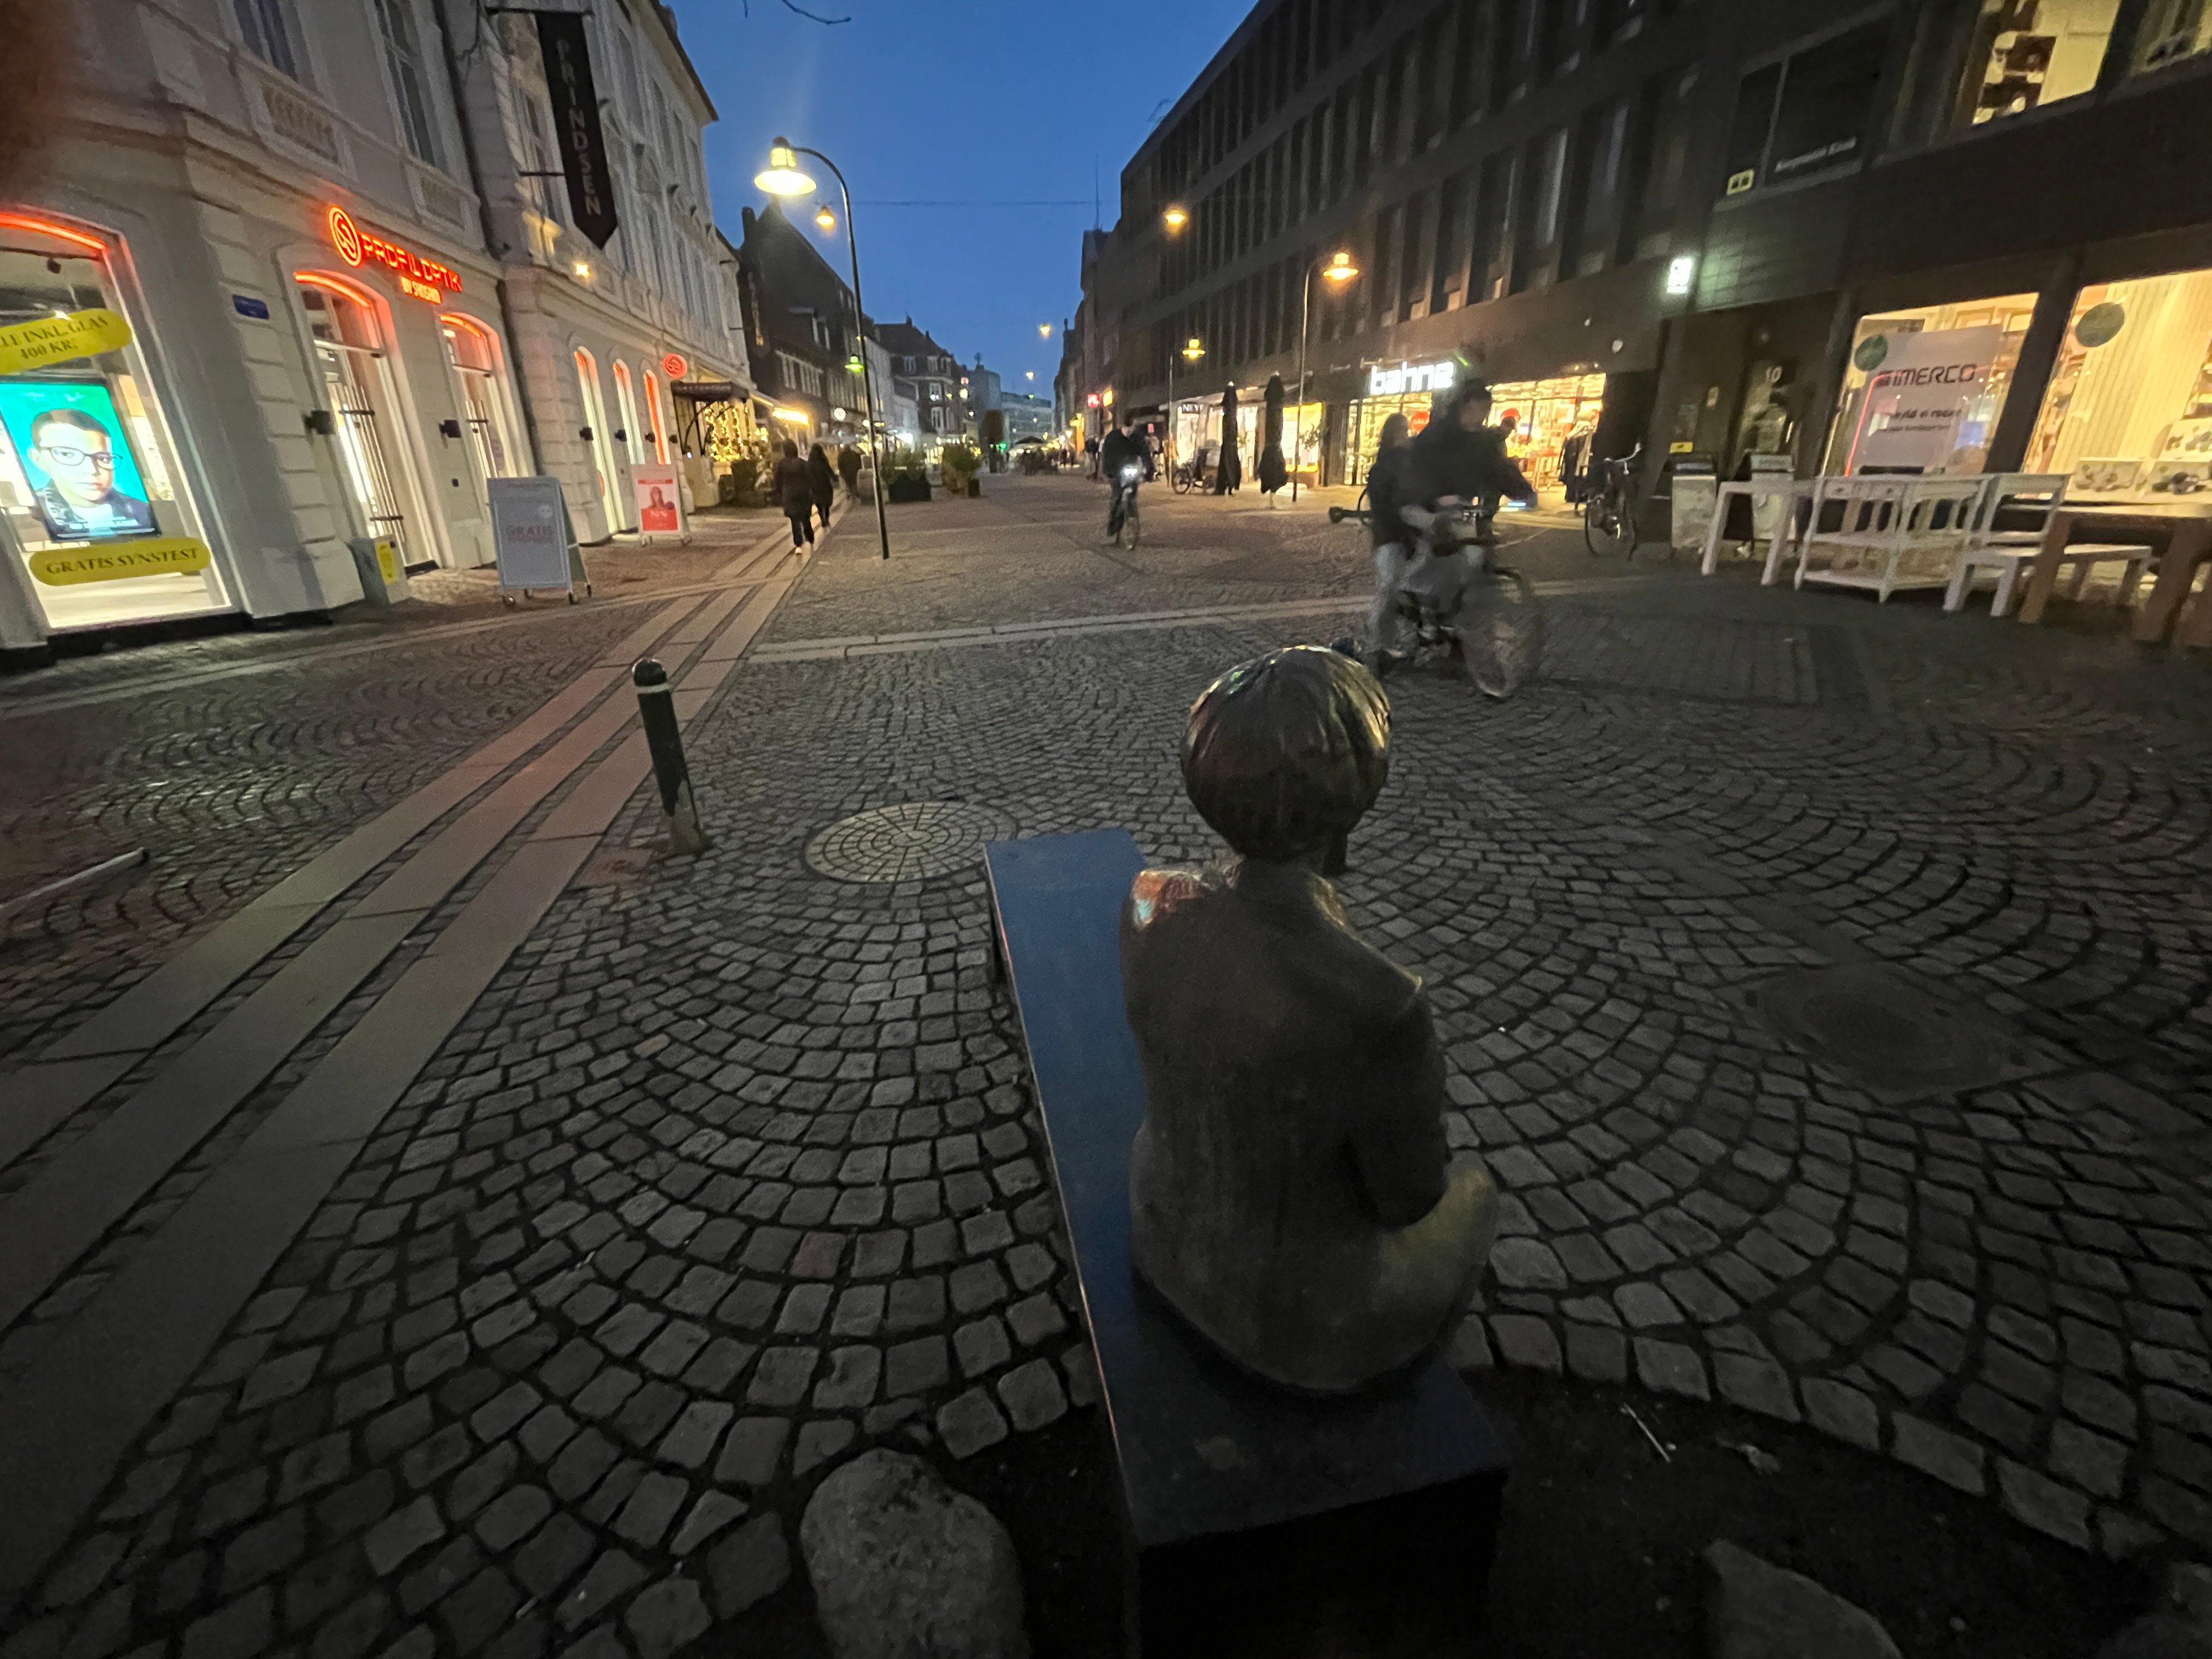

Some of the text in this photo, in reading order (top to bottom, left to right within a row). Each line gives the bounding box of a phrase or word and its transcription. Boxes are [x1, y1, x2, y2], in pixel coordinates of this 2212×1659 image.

[1370, 360, 1454, 396] bahne
[1765, 366, 1782, 383] 10
[46, 548, 198, 574] GRATIS SYNSTEST
